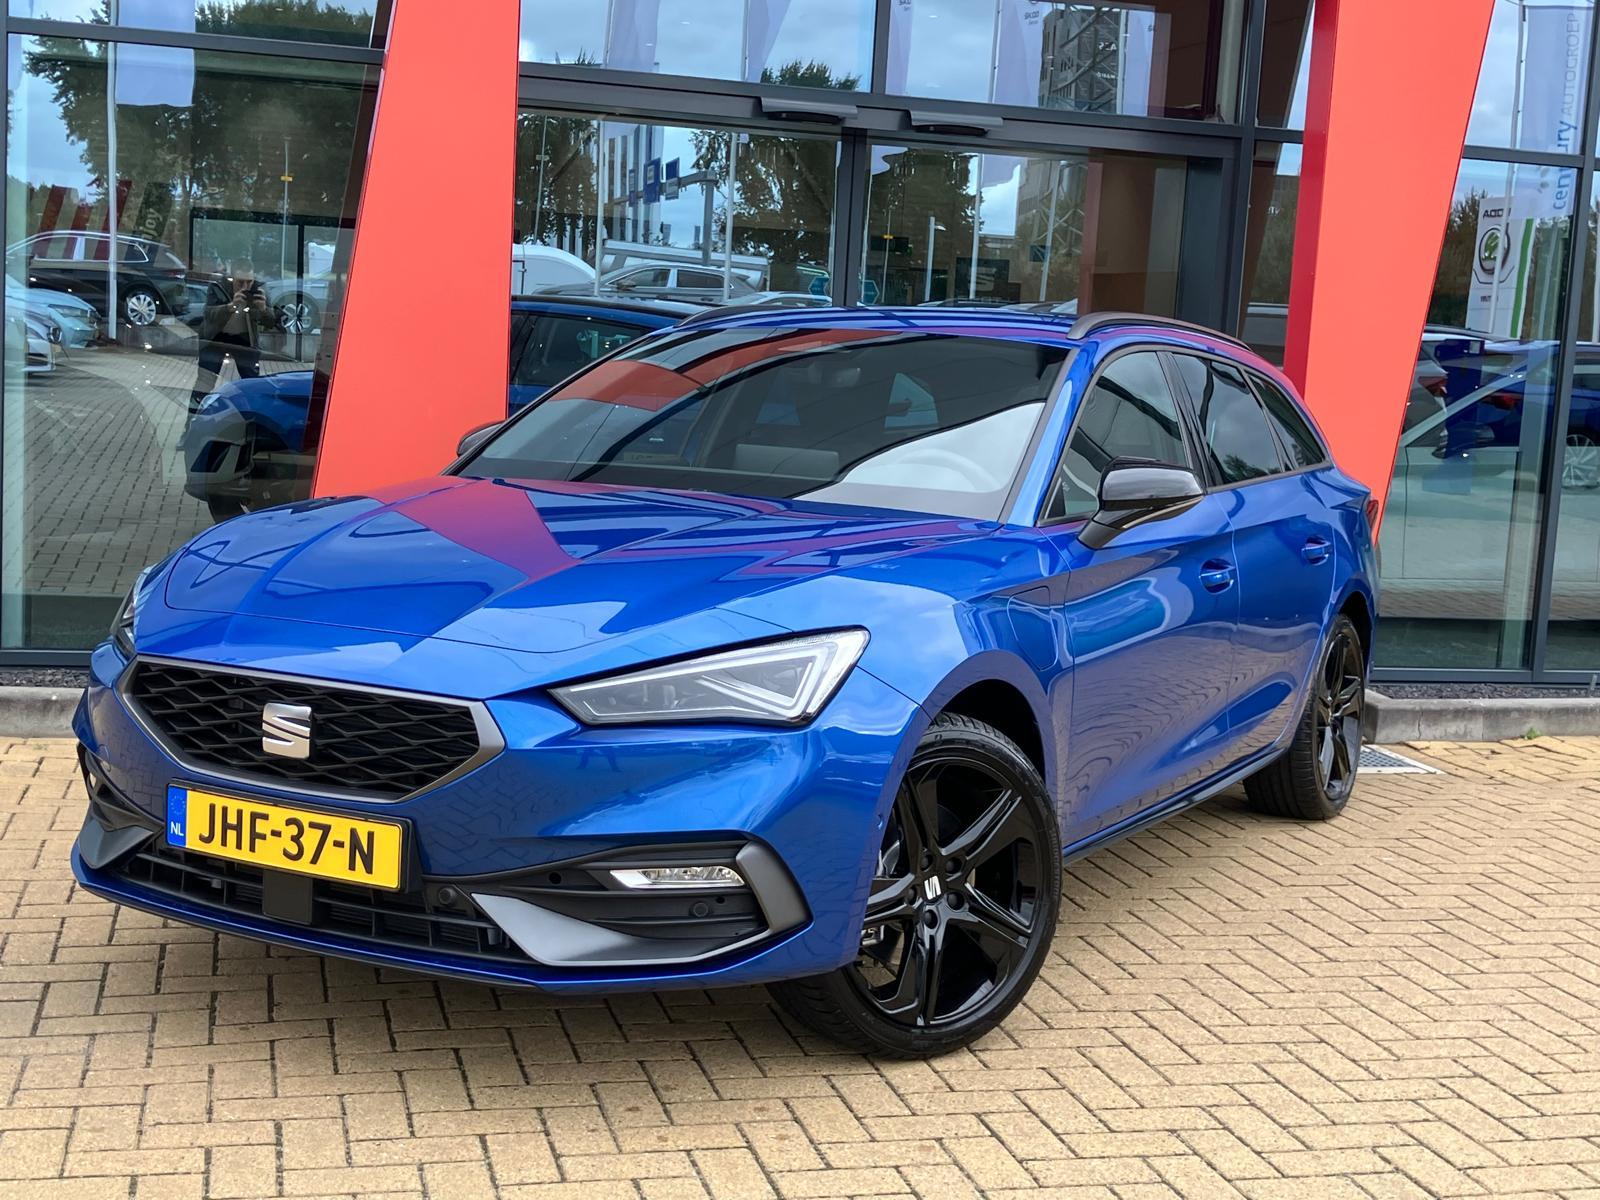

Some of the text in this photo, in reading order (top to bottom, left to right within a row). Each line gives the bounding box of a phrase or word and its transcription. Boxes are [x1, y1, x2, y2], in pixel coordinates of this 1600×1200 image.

[1552, 12, 1580, 210] cenury AUTOGROEP
[170, 821, 184, 837] NL
[198, 803, 375, 875] JHF-37-N
